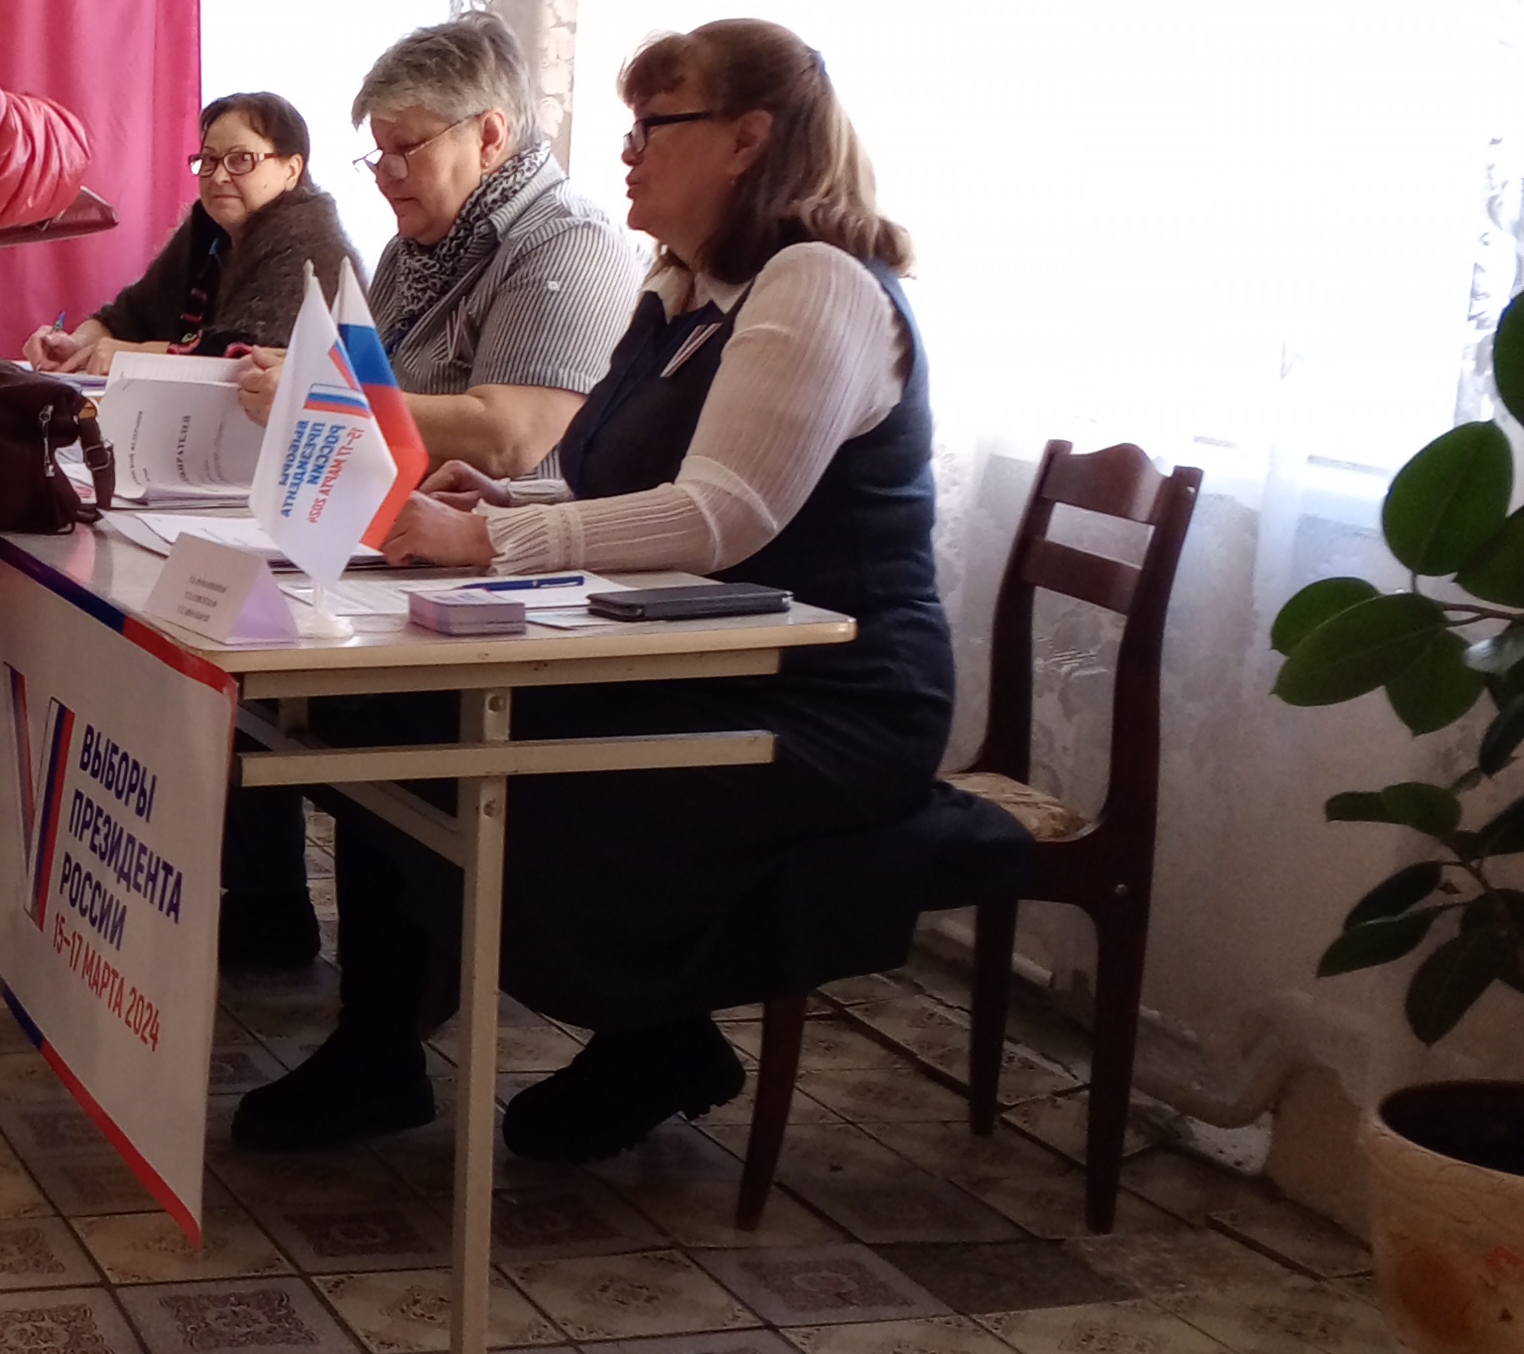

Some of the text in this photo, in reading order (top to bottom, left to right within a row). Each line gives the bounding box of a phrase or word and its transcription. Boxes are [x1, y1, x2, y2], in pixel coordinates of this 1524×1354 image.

[78, 722, 158, 824] ВЫБОРЫ
[59, 850, 128, 952] РОССИИ
[68, 787, 184, 925] ПРЕЗИДЕНТА
[80, 941, 124, 1021] МАРТА
[124, 984, 160, 1053] 2024
